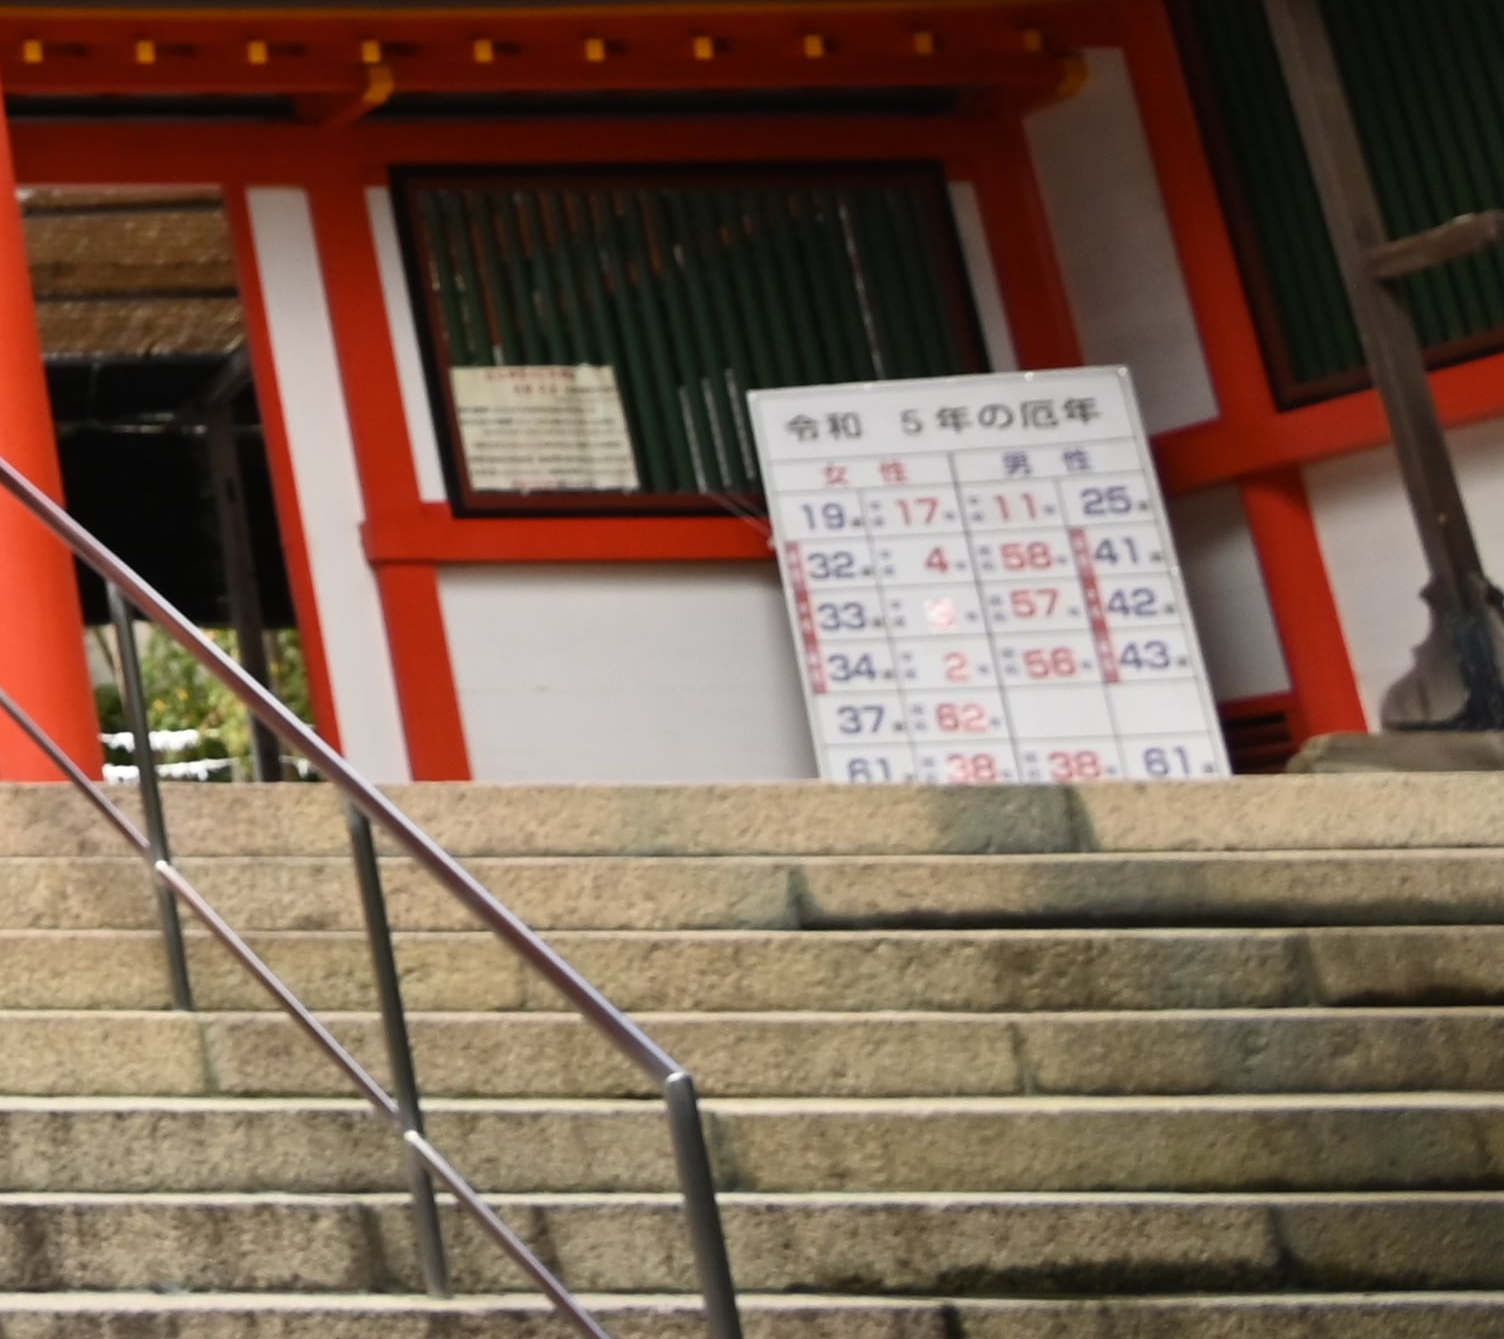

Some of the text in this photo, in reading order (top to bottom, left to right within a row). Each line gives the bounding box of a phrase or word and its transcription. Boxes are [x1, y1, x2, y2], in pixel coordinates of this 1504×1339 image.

[788, 397, 1100, 441] 令和 5年の厄年
